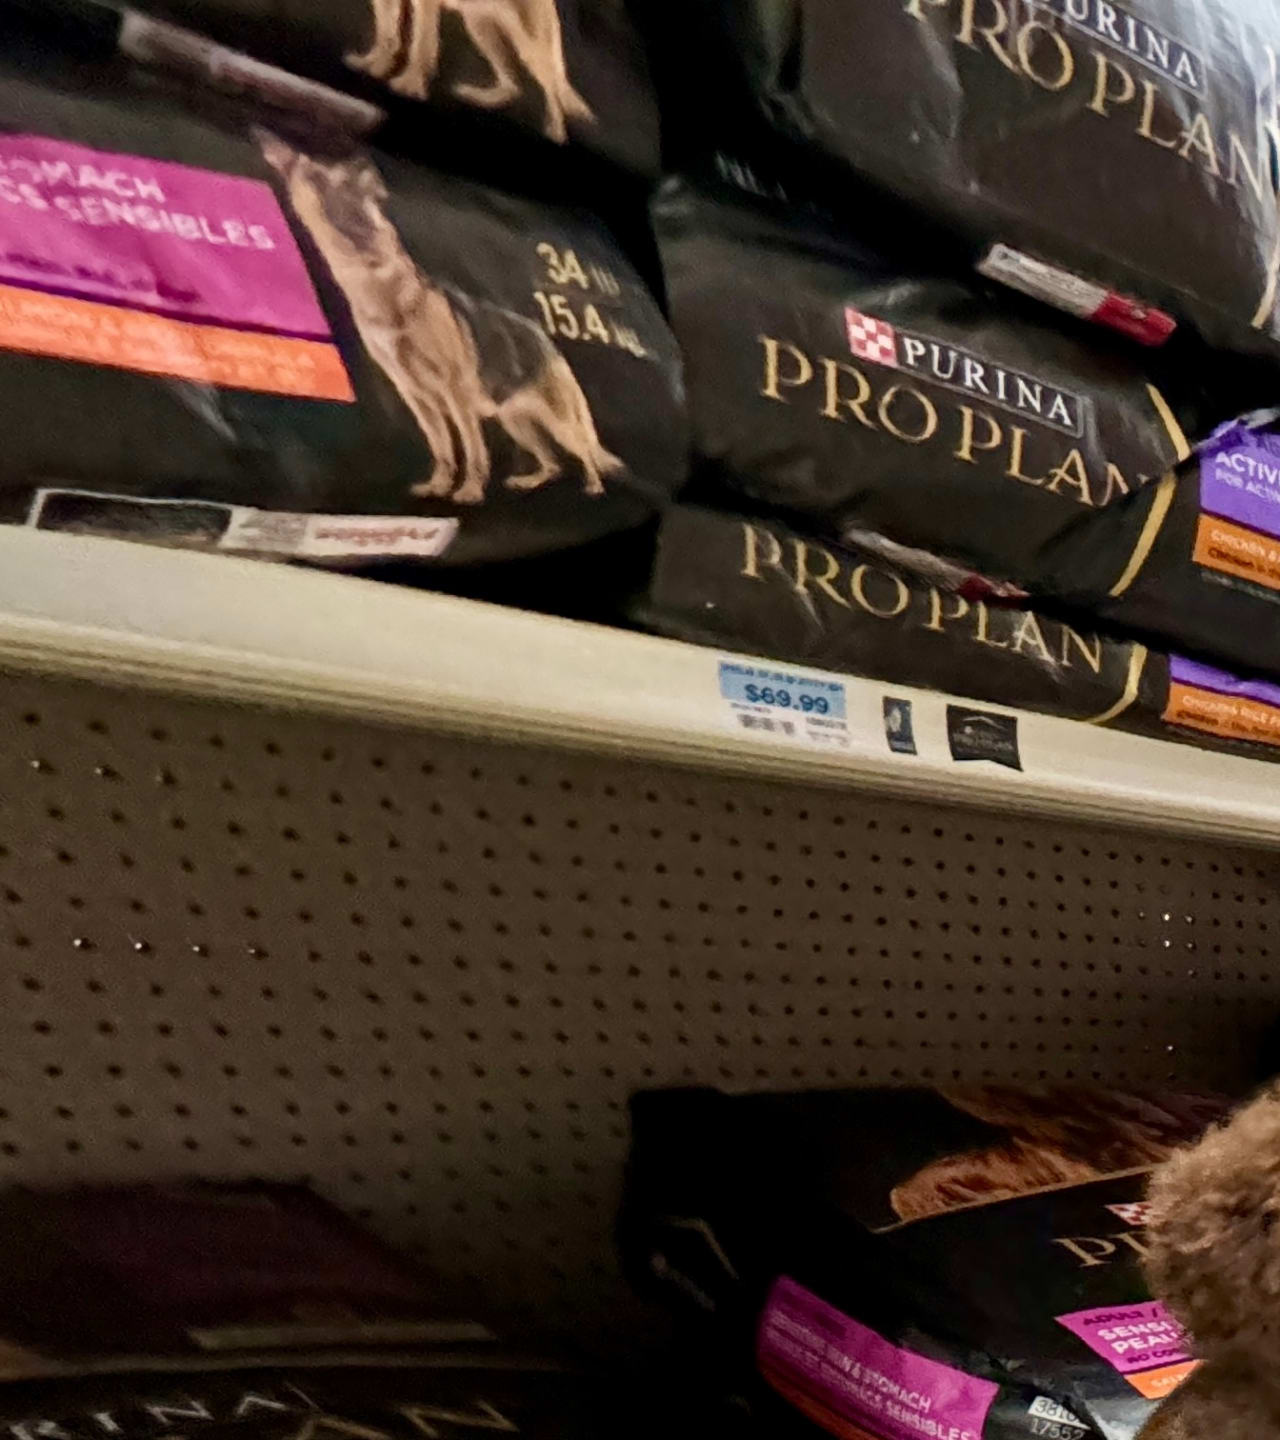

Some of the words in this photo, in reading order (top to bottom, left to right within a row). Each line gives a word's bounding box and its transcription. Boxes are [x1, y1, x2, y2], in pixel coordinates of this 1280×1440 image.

[905, 0, 1074, 91] RO
[1062, 0, 1197, 88] URINA
[0, 155, 166, 204] OMACH
[54, 196, 276, 250] SENSIBLES
[536, 241, 590, 290] 34
[532, 290, 611, 345] 15.4
[758, 335, 938, 444] PRO
[903, 334, 1077, 428] PURINA
[740, 522, 910, 619] PRO
[923, 587, 1103, 674] PLAN
[744, 682, 830, 715] $69.99
[1083, 1309, 1144, 1327] ADULT
[1097, 1320, 1174, 1342] SENSI
